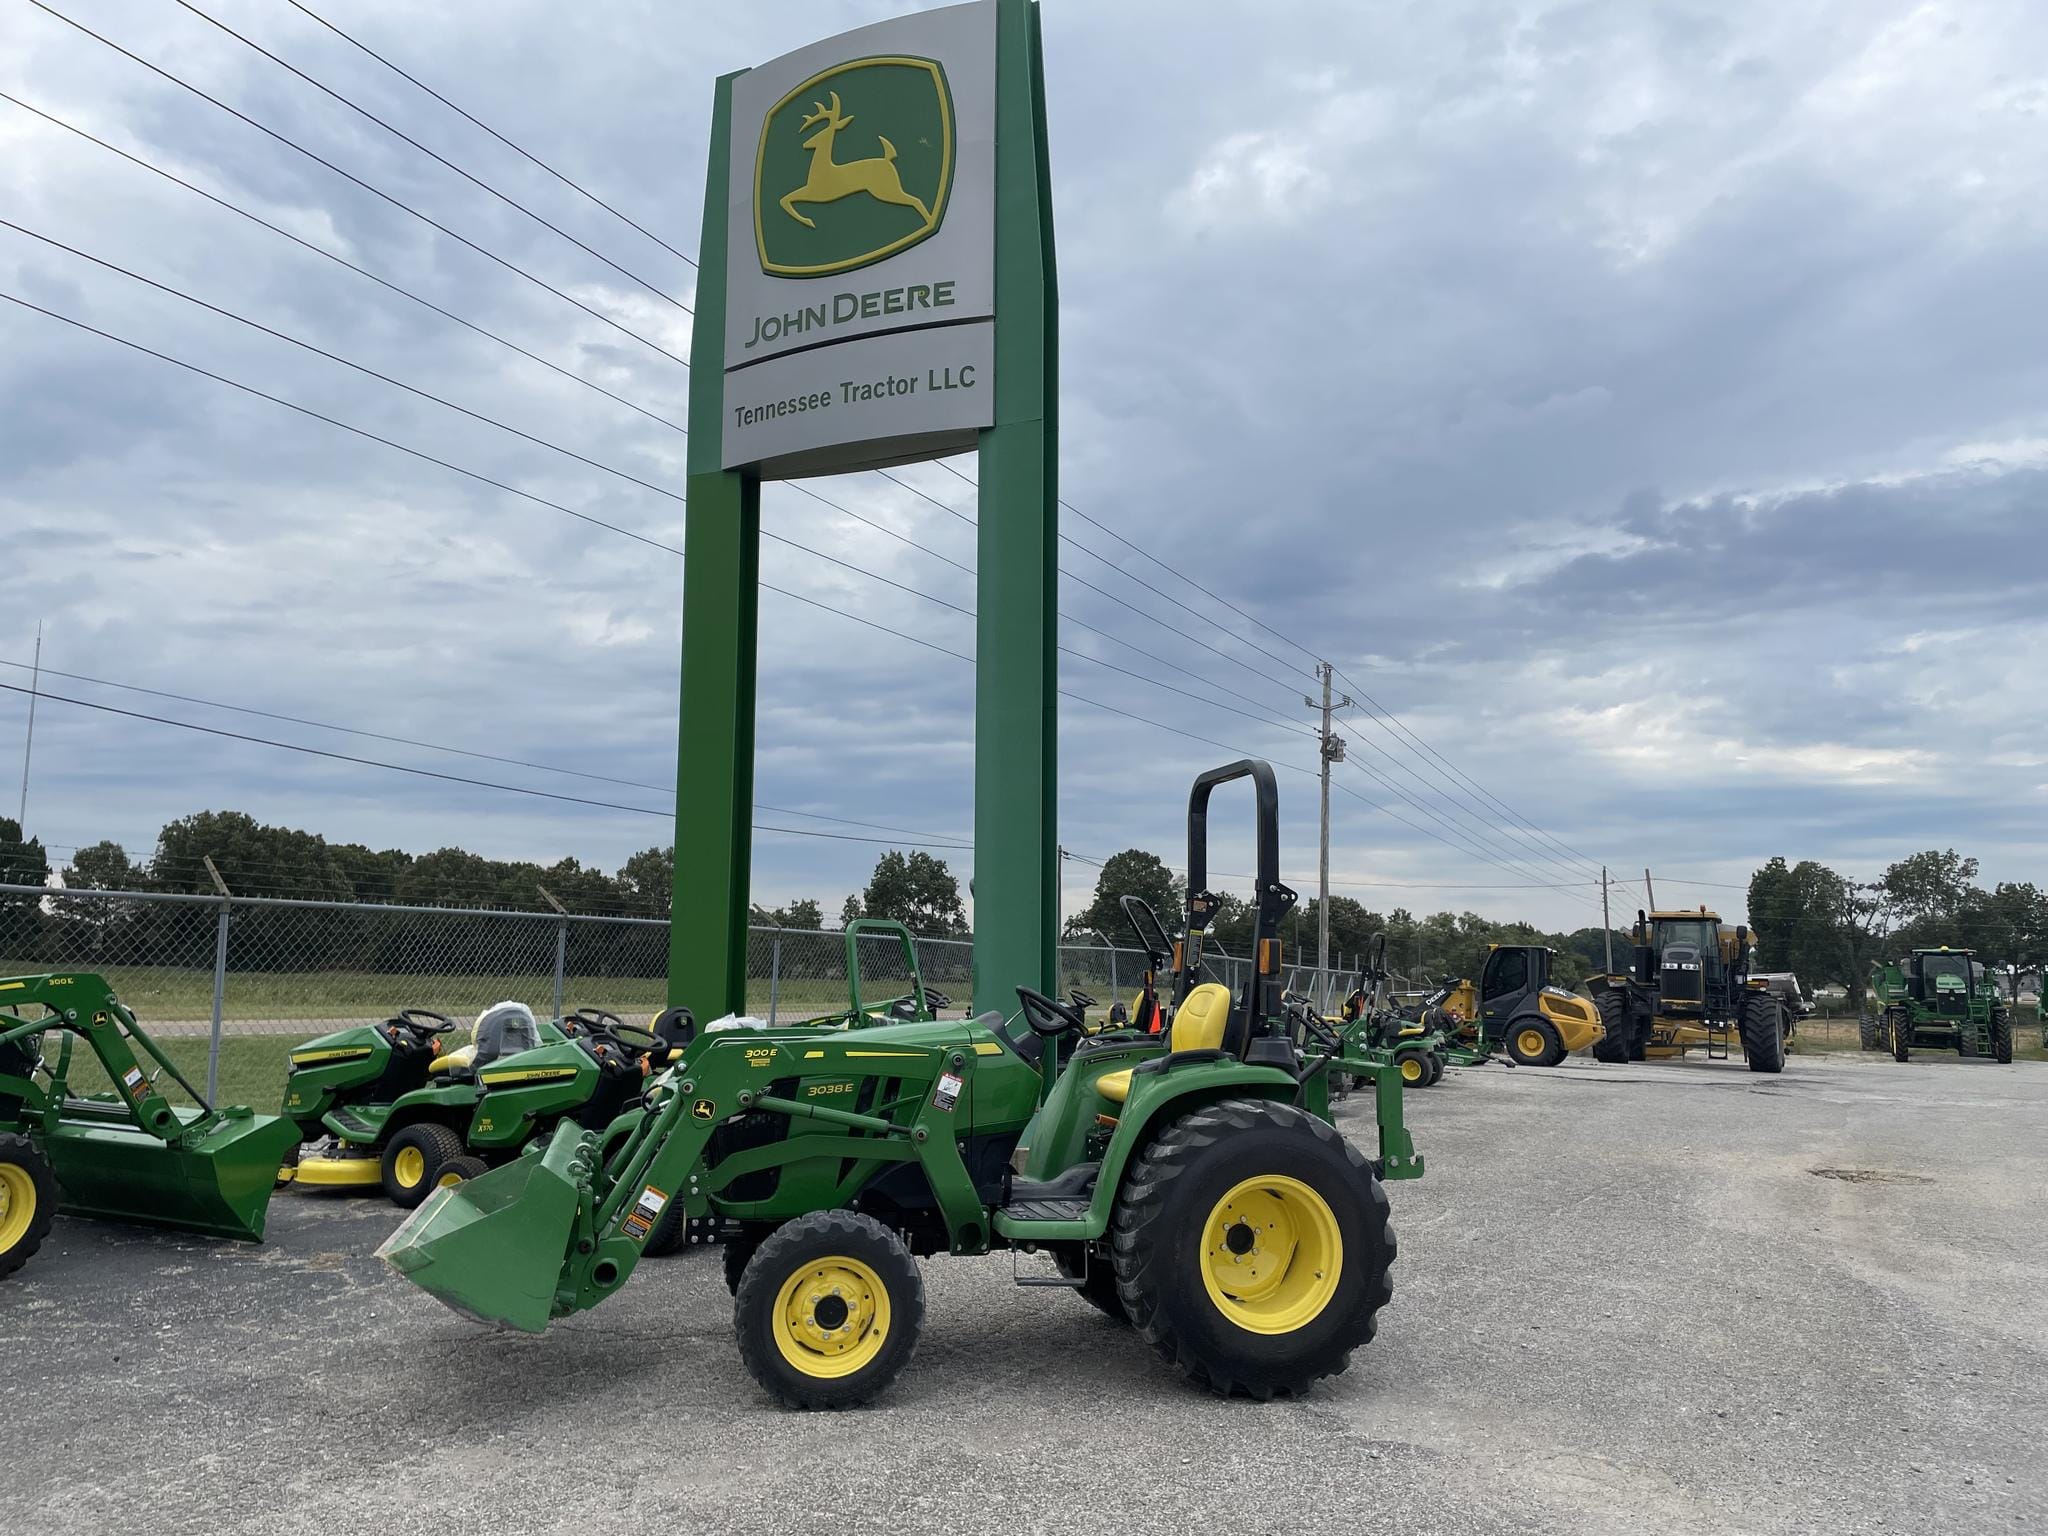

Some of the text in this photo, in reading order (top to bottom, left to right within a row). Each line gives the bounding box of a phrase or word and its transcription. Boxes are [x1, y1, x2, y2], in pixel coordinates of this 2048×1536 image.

[745, 281, 956, 348] JOHN DEERE
[735, 365, 976, 427] Tennessee Tractor LLC
[1426, 988, 1447, 1005] DEERE
[525, 1070, 561, 1080] JOHN DEERE
